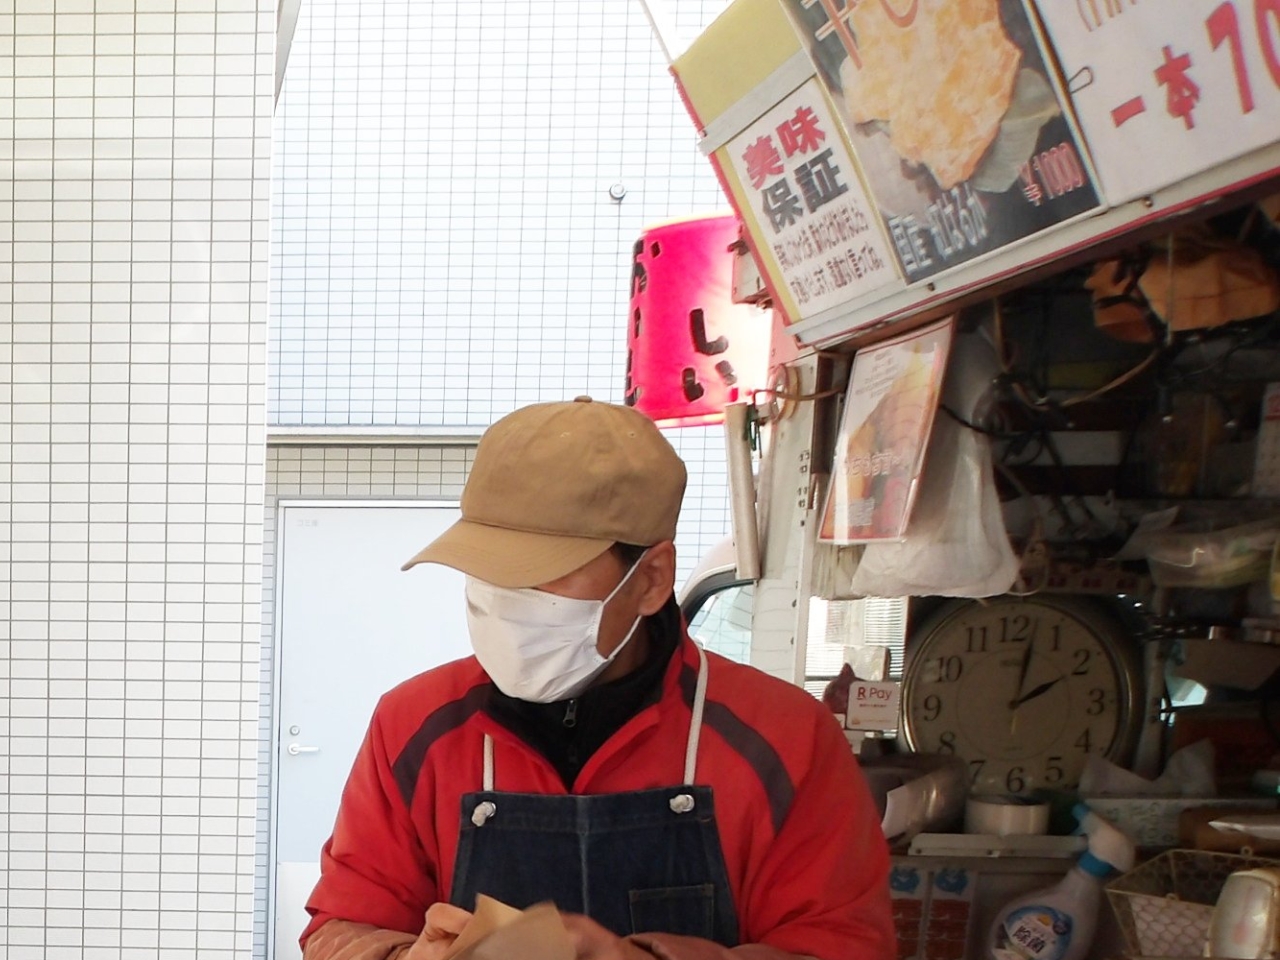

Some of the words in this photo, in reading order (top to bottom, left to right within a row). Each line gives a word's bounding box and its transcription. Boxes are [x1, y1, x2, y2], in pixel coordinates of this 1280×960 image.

[742, 106, 826, 191] 美味
[761, 147, 849, 235] 保証
[965, 626, 989, 652] 11
[999, 615, 1030, 643] 12
[1050, 624, 1063, 651] 1
[933, 655, 964, 683] 10
[1072, 648, 1091, 676] 2
[869, 687, 893, 700] Pay
[1086, 688, 1105, 716] 3
[923, 694, 942, 722] 9
[938, 731, 956, 755] 8
[1074, 727, 1093, 753] 4
[970, 759, 987, 789] 7
[1006, 767, 1025, 793] 6
[1045, 756, 1063, 782] 5
[1013, 926, 1046, 953] 除菌
